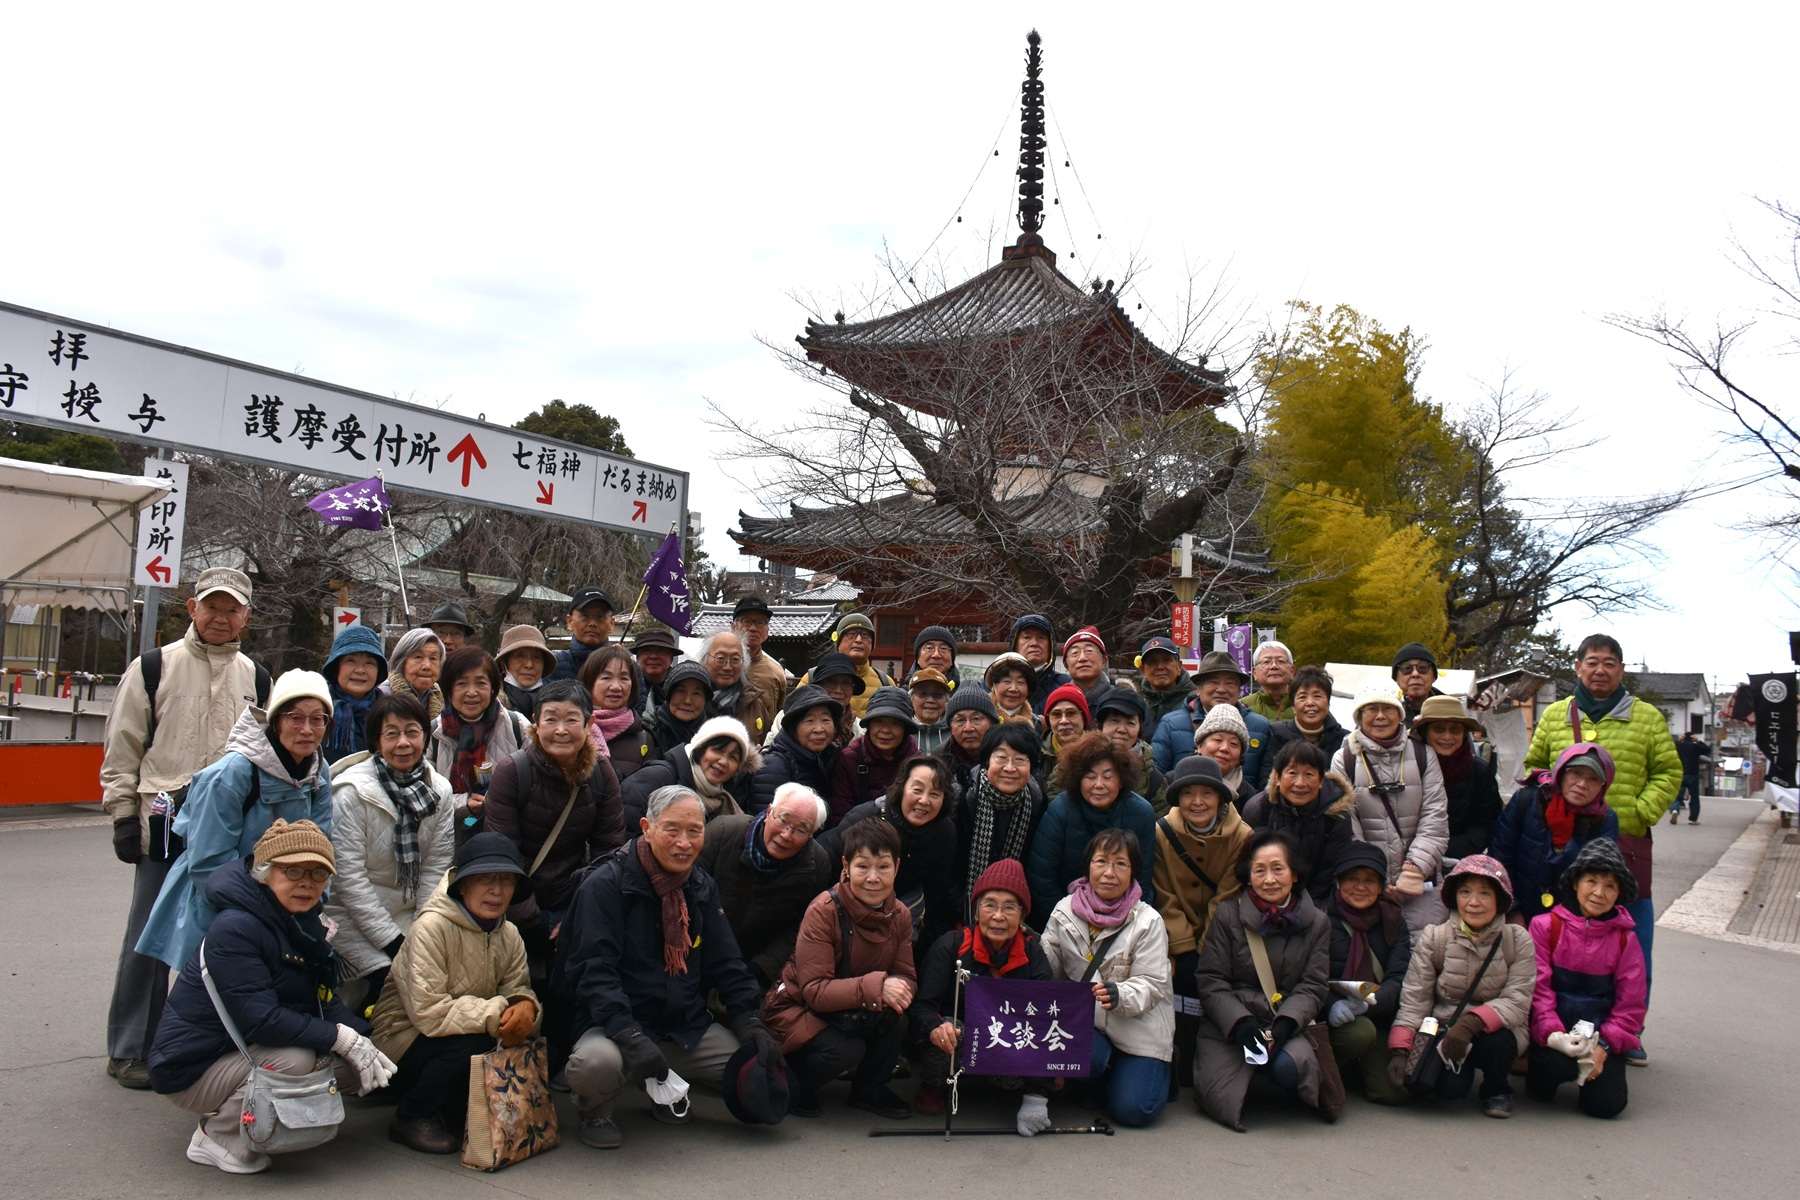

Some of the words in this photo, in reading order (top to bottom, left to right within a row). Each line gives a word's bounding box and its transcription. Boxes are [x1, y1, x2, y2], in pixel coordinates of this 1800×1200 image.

[49, 330, 90, 371] 拝
[245, 394, 440, 474] 護摩受付所
[513, 440, 582, 481] 七福神
[602, 463, 677, 502] だるま納め
[999, 1000, 1061, 1018] 小金井
[985, 1016, 1074, 1052] 史談会
[1046, 1063, 1065, 1071] SINCE
[1067, 1063, 1081, 1071] 1971
